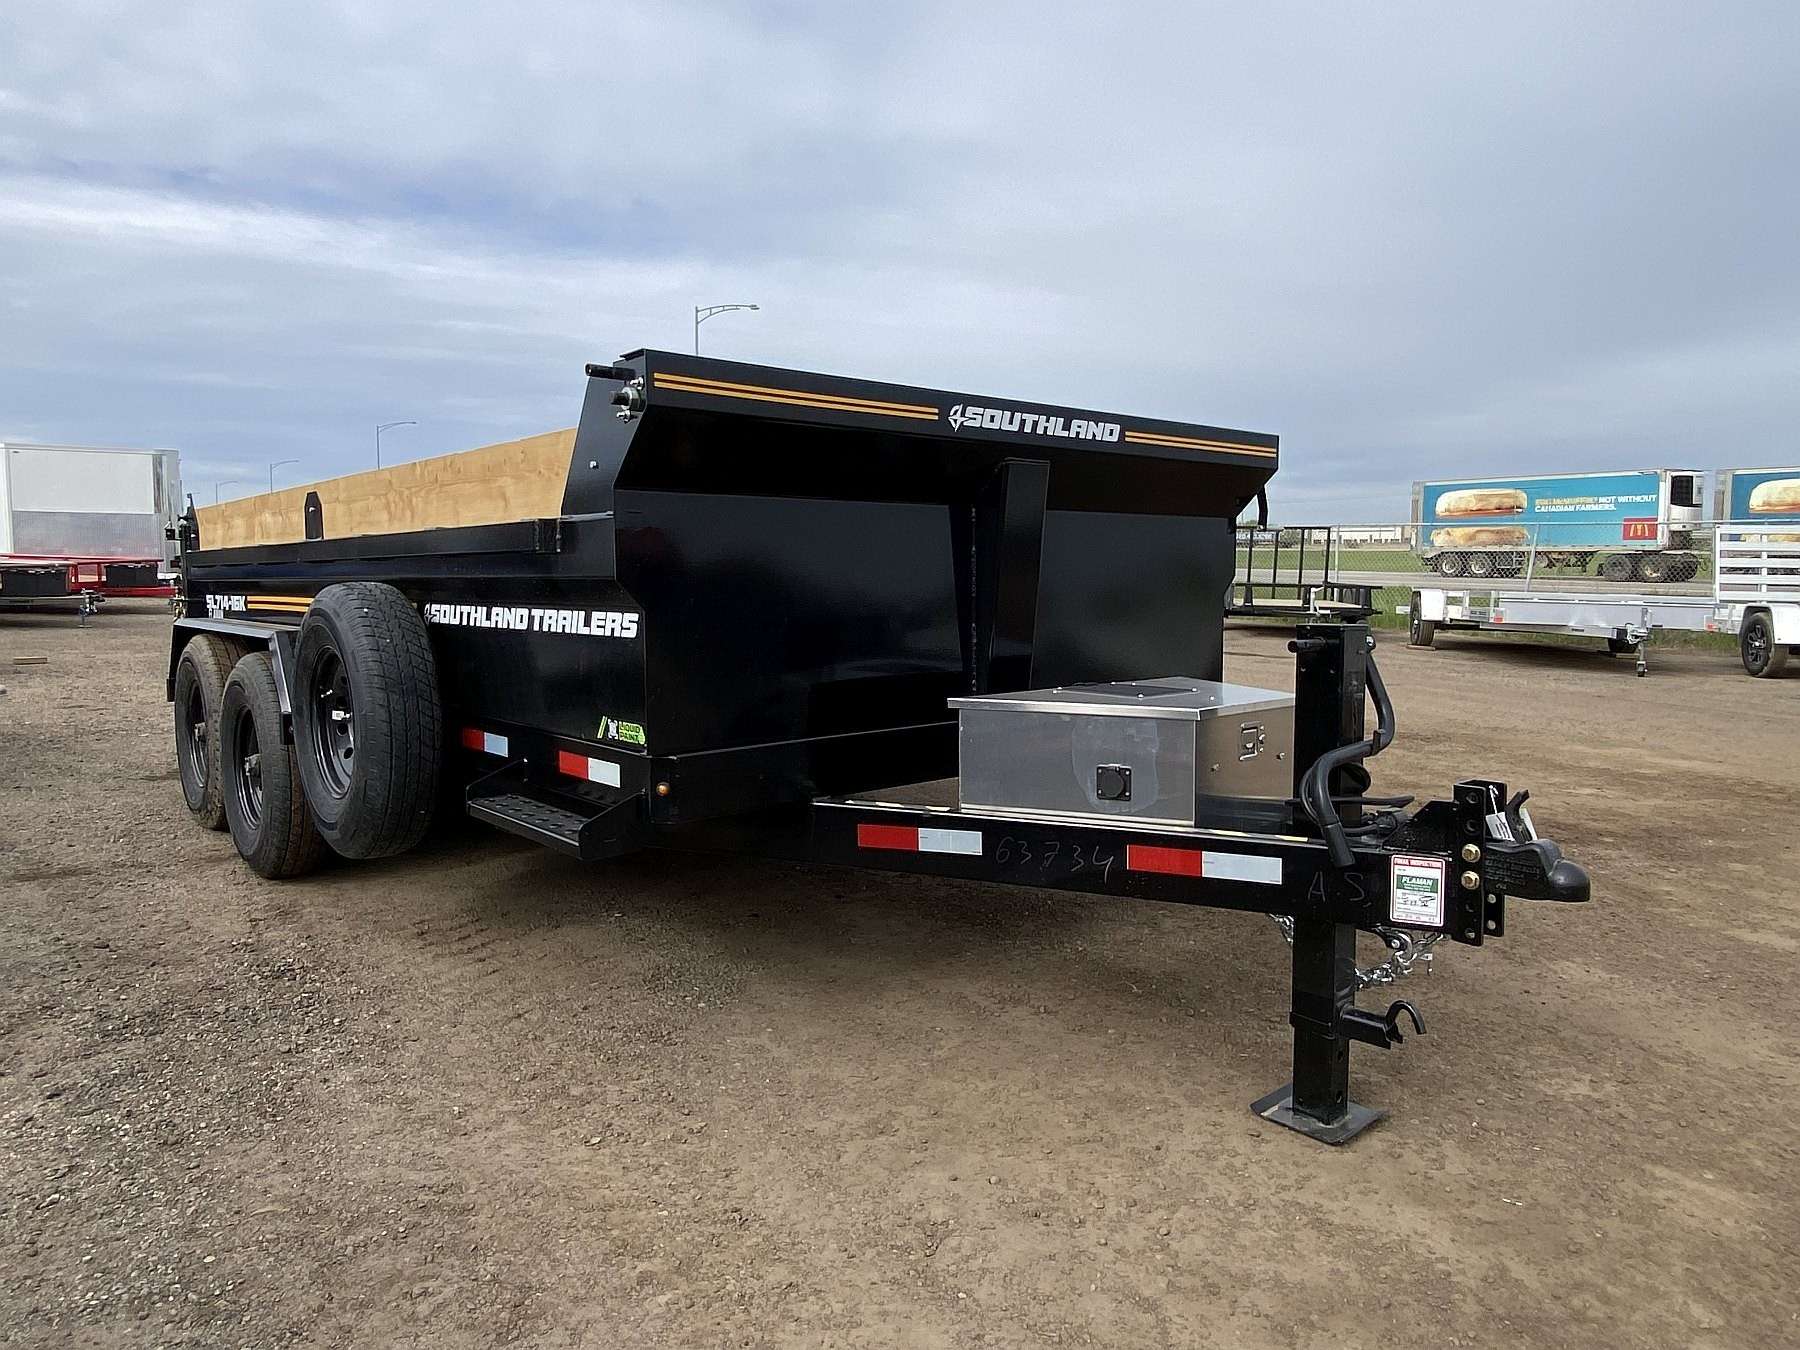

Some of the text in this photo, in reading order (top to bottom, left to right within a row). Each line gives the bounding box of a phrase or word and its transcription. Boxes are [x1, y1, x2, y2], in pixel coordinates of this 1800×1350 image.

[963, 406, 1121, 442] SOUTHLAND
[431, 604, 639, 638] SOUTHLAND TRAILERS
